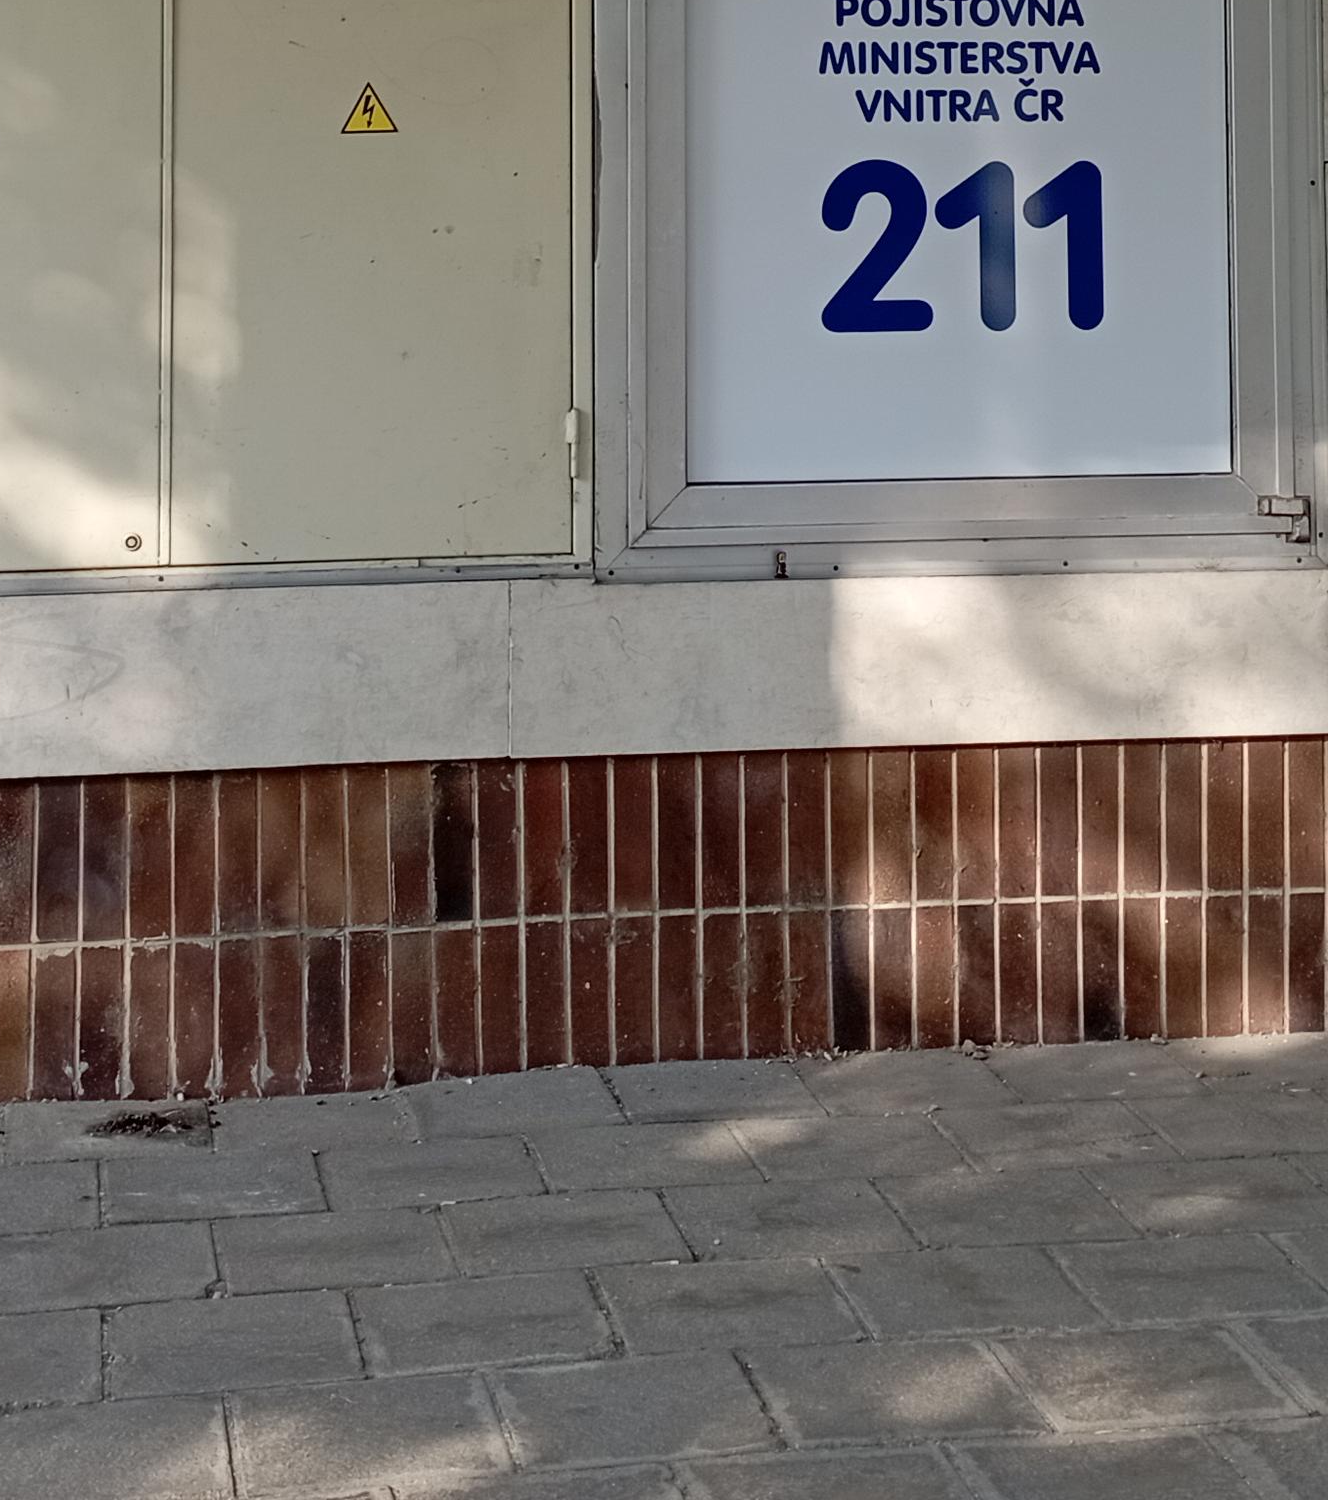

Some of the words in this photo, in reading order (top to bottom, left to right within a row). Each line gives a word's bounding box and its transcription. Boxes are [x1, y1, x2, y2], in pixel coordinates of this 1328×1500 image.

[818, 40, 1101, 76] MINISTERSTVA
[854, 88, 1001, 123] VNITRA
[1012, 77, 1065, 123] ČR
[820, 158, 1105, 334] 211
